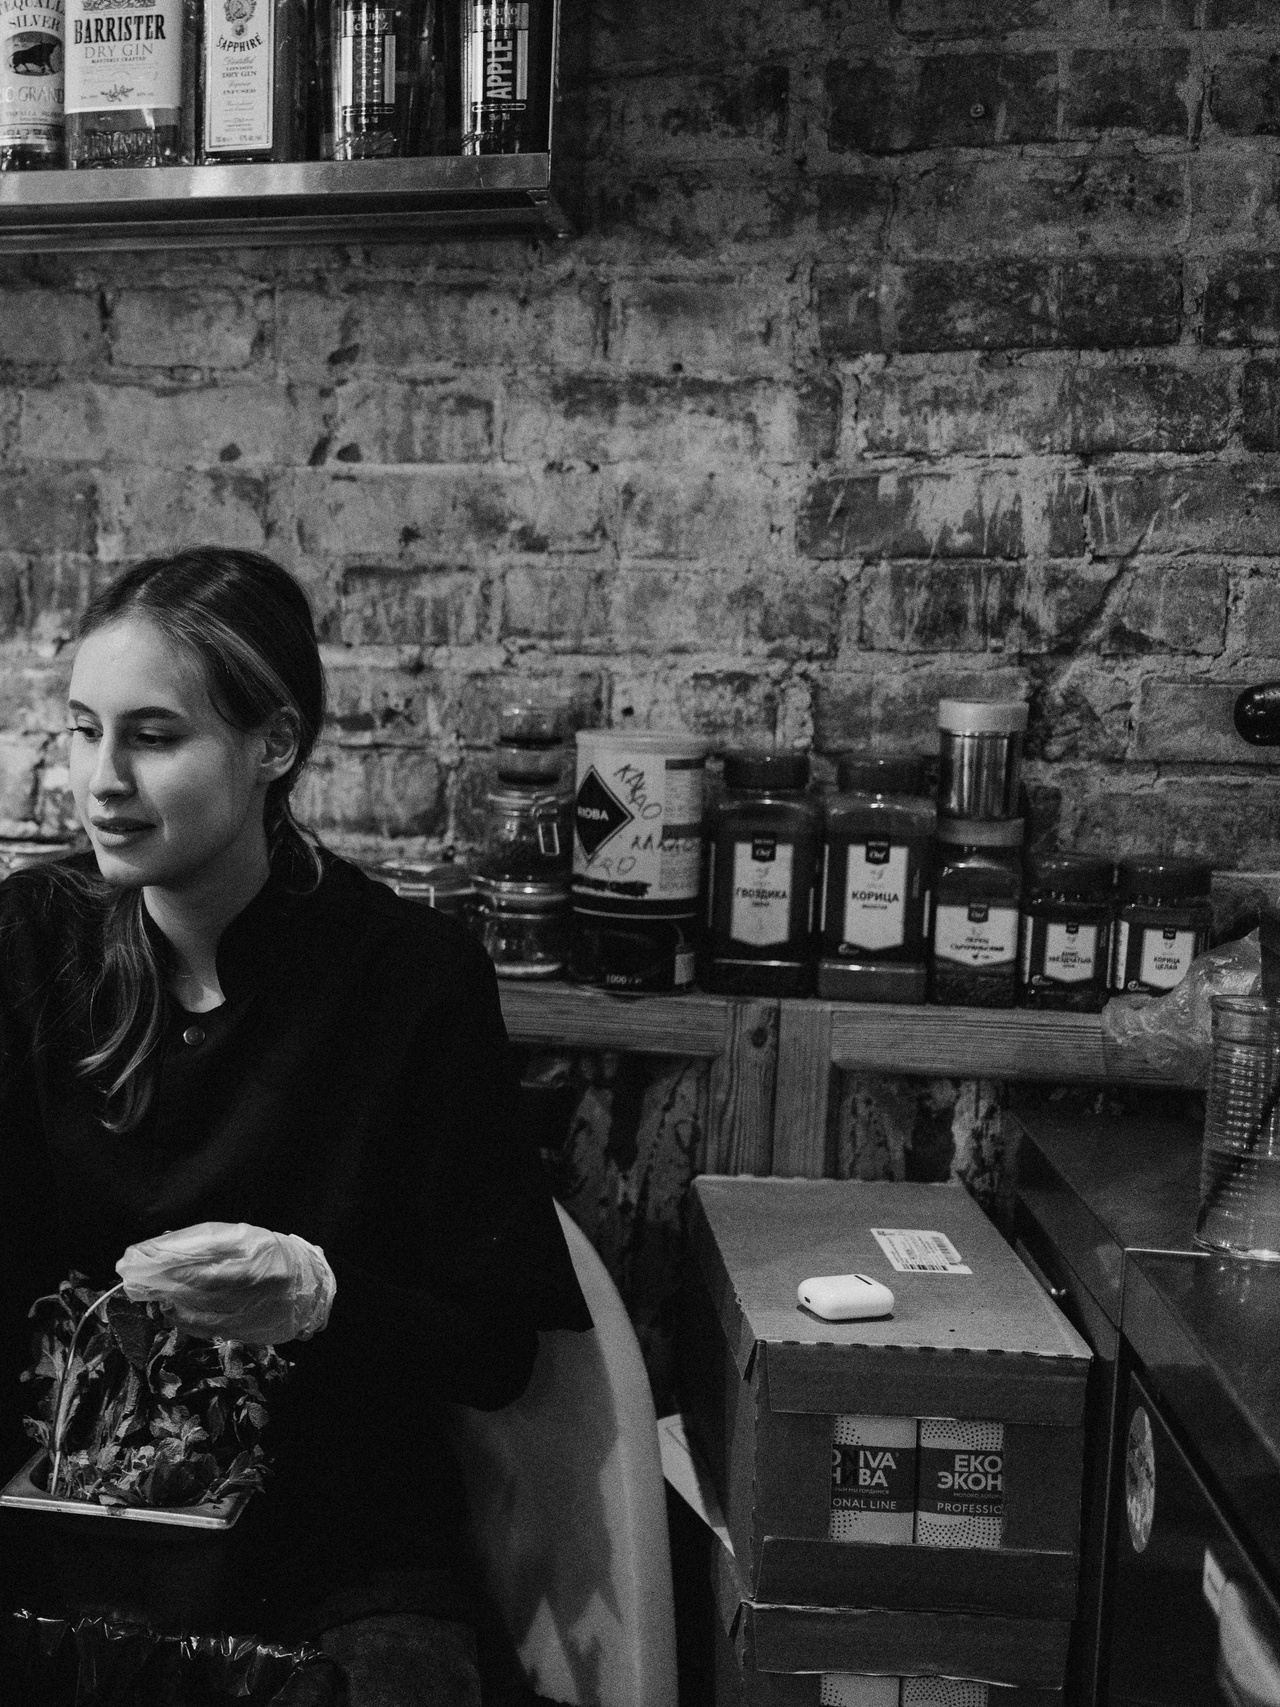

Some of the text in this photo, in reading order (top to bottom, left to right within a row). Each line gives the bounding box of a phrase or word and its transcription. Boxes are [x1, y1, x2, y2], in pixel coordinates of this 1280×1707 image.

[8, 14, 61, 31] SILVER
[74, 14, 166, 44] BARRISTER
[85, 43, 154, 59] DRY GIN
[216, 34, 263, 52] SAPPHIRE
[486, 40, 513, 100] APPLE
[736, 886, 788, 899] ГВОЗДИКА
[851, 890, 900, 904] КОРИЦА
[954, 1454, 1003, 1473] EKO
[937, 1471, 1003, 1491] ЭКОН
[870, 1500, 897, 1510] LINE
